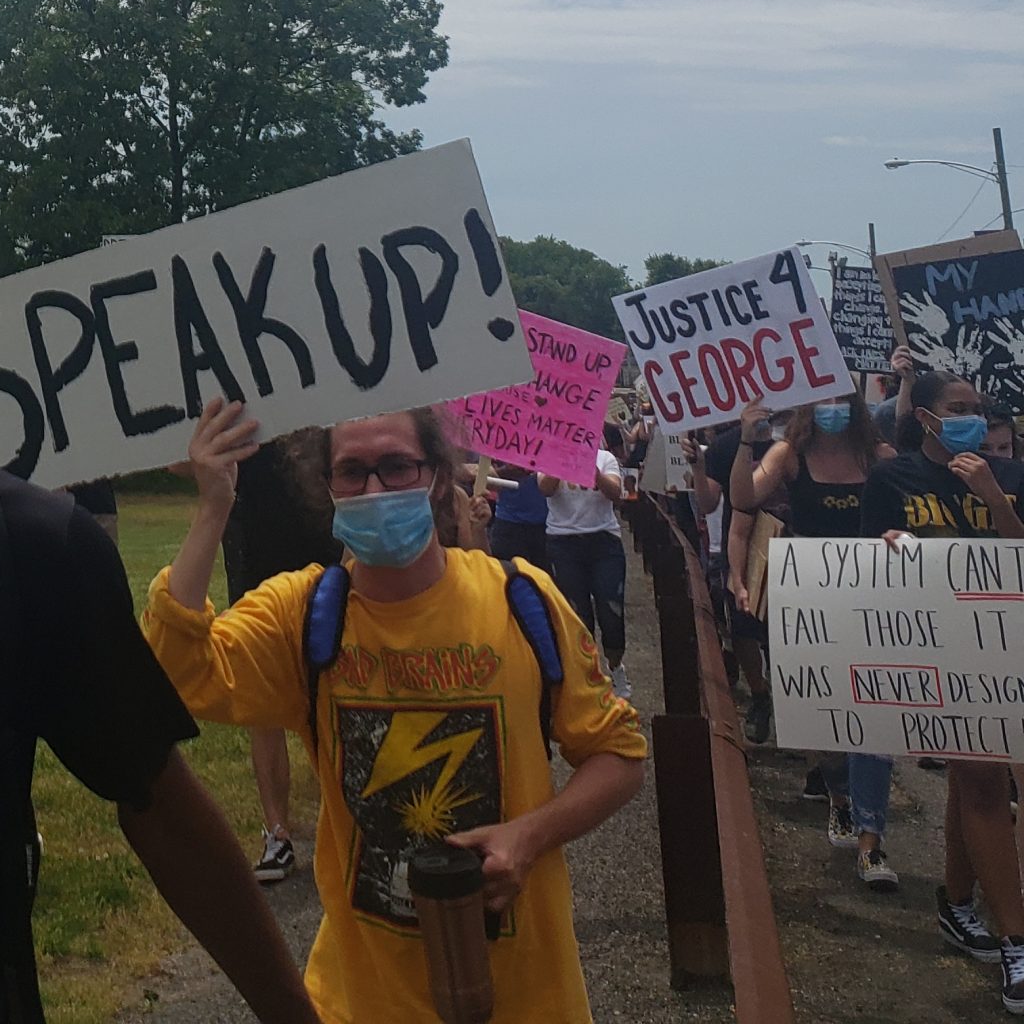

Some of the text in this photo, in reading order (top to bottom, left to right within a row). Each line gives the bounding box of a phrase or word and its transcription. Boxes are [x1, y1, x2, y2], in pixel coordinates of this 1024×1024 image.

[312, 208, 516, 390] UP!
[624, 250, 807, 350] JUSTICE 4
[926, 260, 978, 296] MY
[527, 328, 576, 363] STAND
[527, 370, 601, 411] HANGE
[644, 318, 836, 423] GEORGE
[465, 396, 596, 448] LIVES MATTER
[780, 543, 799, 587] A
[819, 542, 924, 588] SYSTEM
[781, 607, 1008, 651] FAIL THOSE IT
[777, 664, 833, 698] WAS
[853, 668, 938, 703] NEVER
[818, 709, 864, 746] TO
[901, 712, 1009, 754] PROTECT
